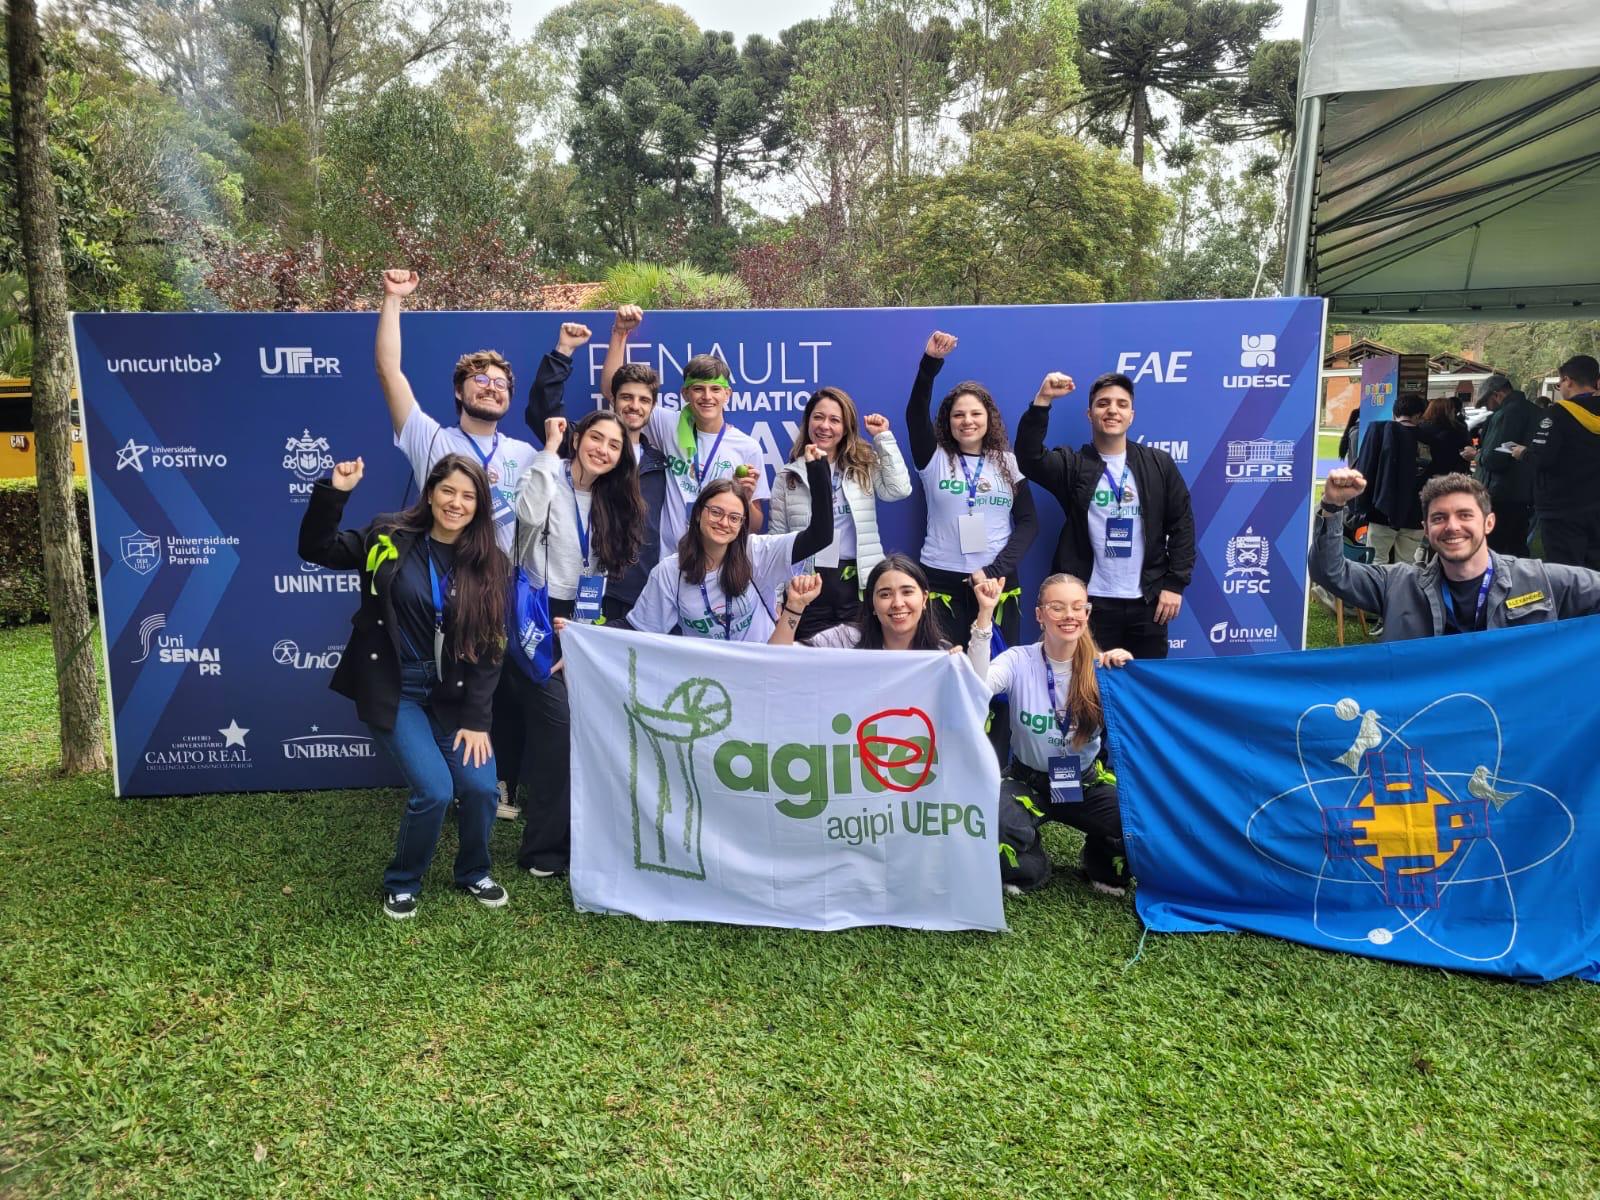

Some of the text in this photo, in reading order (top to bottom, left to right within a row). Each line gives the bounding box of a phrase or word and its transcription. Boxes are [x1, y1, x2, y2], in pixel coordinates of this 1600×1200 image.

[107, 354, 213, 373] unicuritiba
[259, 347, 341, 375] UTFPR
[1116, 351, 1192, 383] FAE
[1223, 374, 1291, 388] UDESC
[10, 435, 25, 448] CAT
[152, 455, 227, 468] POSITIVO
[1225, 464, 1292, 477] UFPR
[167, 536, 240, 545] Universidade
[168, 545, 217, 555] Tuiuti do
[169, 555, 209, 565] Paraná
[274, 575, 361, 593] UNINTER
[1223, 579, 1270, 594] UFSC
[1229, 624, 1277, 638] univel
[158, 634, 183, 648] Uni
[159, 648, 220, 663] SENAI
[199, 663, 221, 675] PR
[145, 750, 252, 764] CAMPO REAL
[713, 713, 938, 819] agite
[827, 801, 987, 846] agipi UEPG
